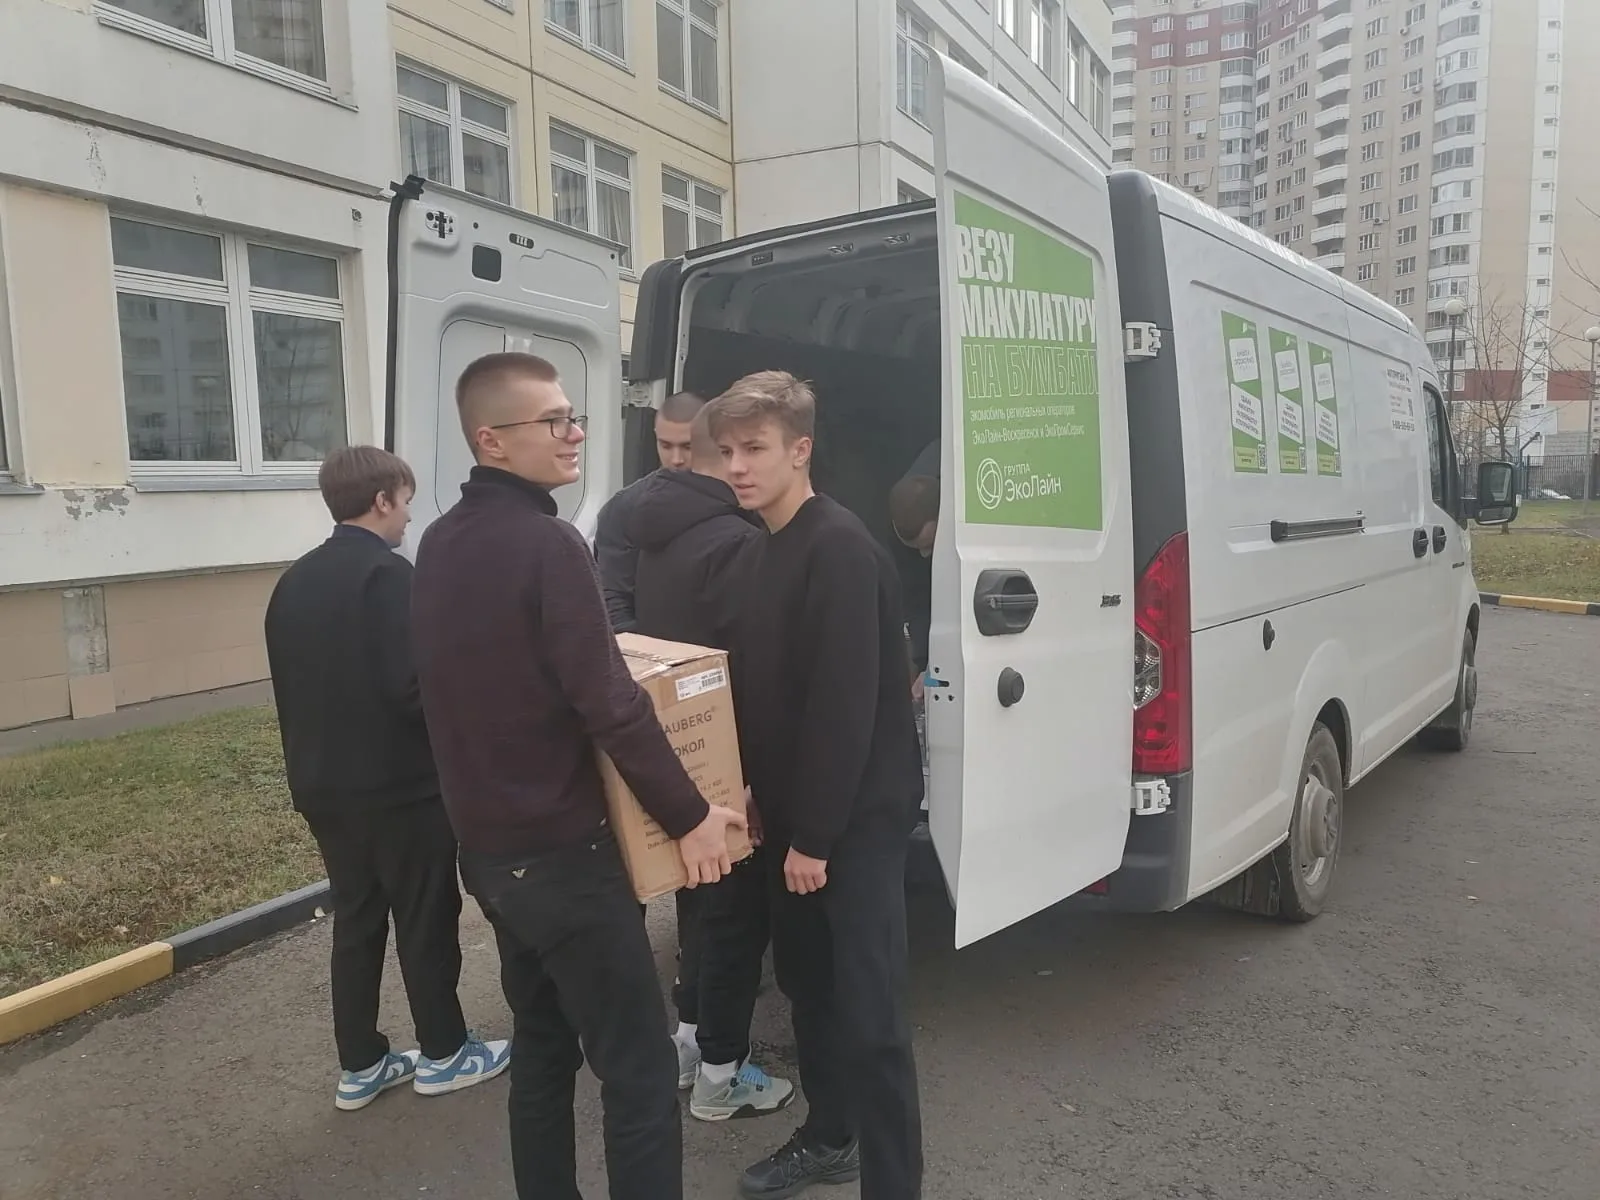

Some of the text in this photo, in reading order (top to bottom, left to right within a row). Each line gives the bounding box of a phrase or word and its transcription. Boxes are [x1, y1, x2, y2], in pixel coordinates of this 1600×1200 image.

[955, 225, 1015, 284] ВЕЗУ
[959, 284, 1097, 343] МАКУЛАТУРУ
[963, 344, 1003, 399] НА
[1003, 463, 1031, 477] ГРУППА
[1004, 474, 1062, 502] ЭкоЛайн
[664, 710, 712, 734] AUBERG
[673, 738, 705, 760] ОКОЛ
